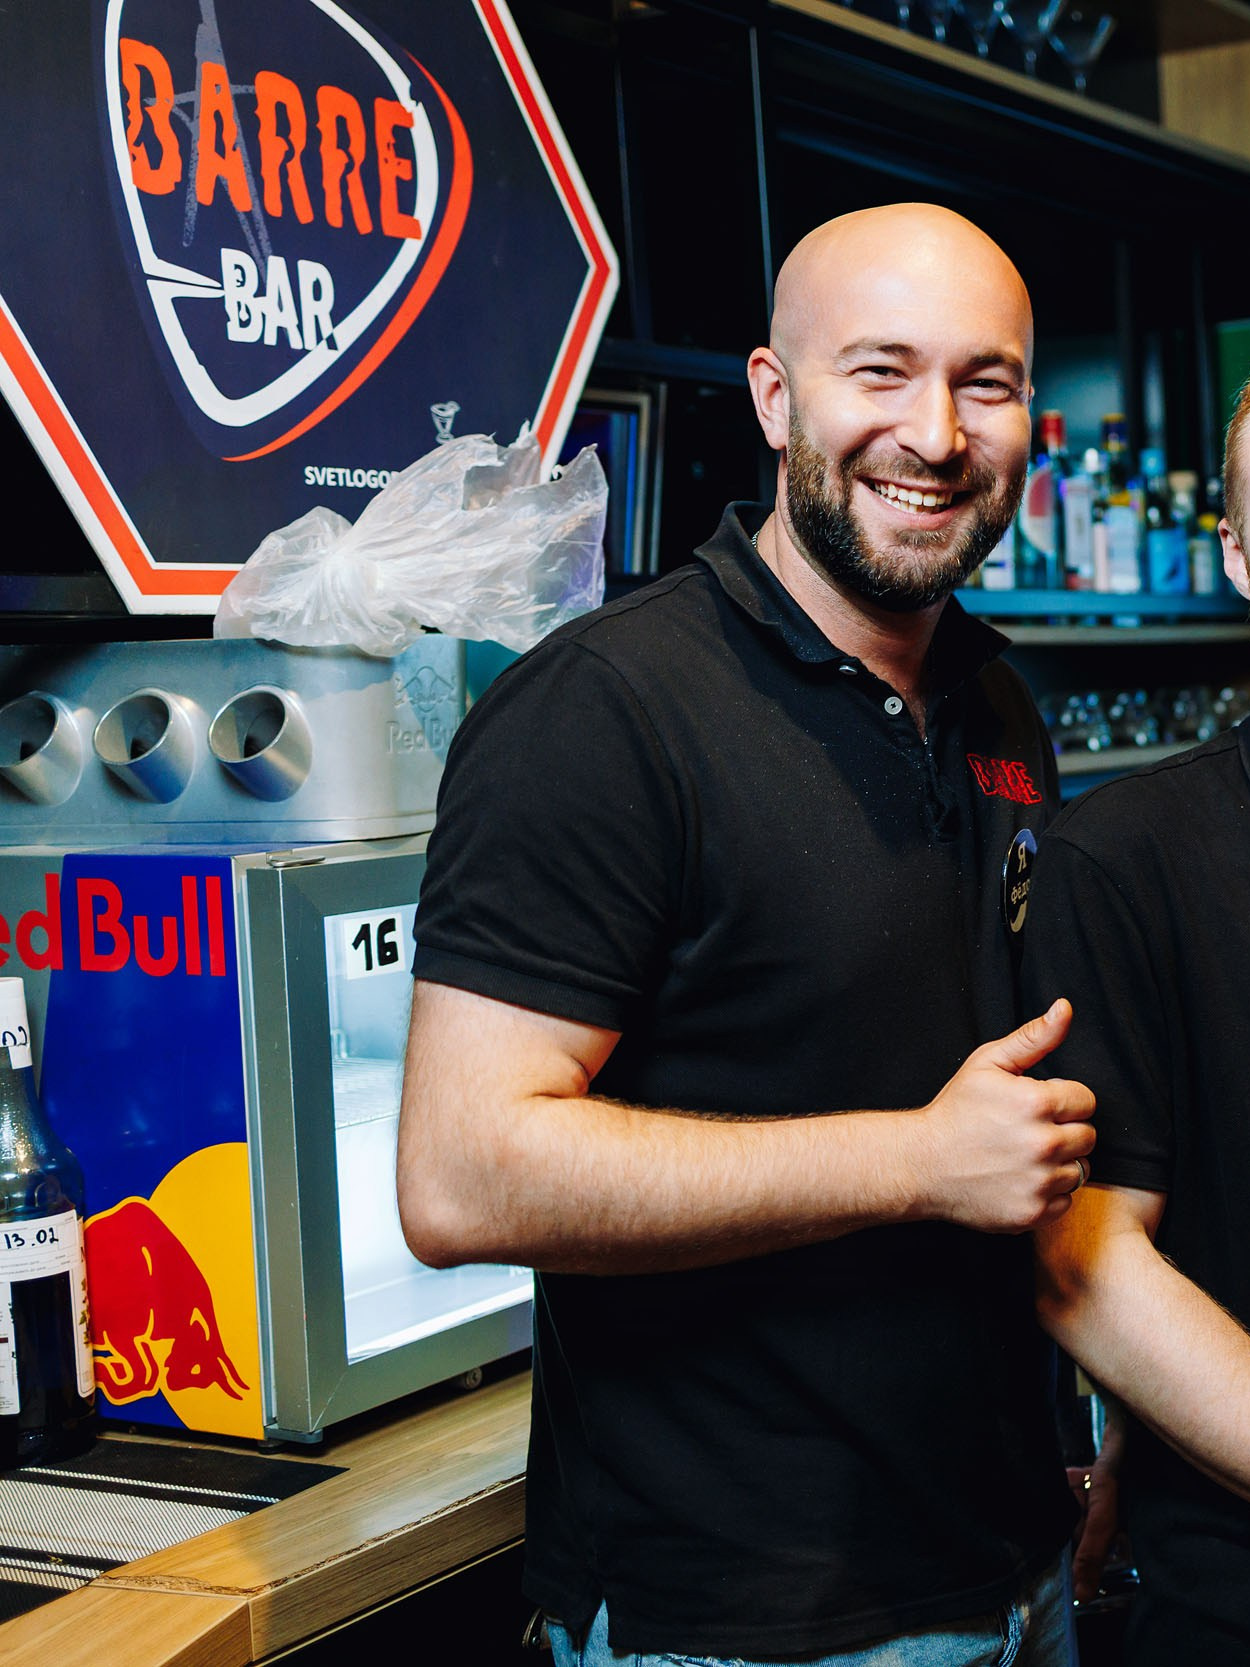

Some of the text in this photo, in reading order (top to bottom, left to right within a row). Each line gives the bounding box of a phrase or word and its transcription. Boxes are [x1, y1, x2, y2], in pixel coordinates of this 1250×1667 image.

[119, 37, 422, 241] BARRE
[220, 247, 340, 352] BAR
[76, 875, 227, 977] Bull
[351, 917, 399, 972] 16
